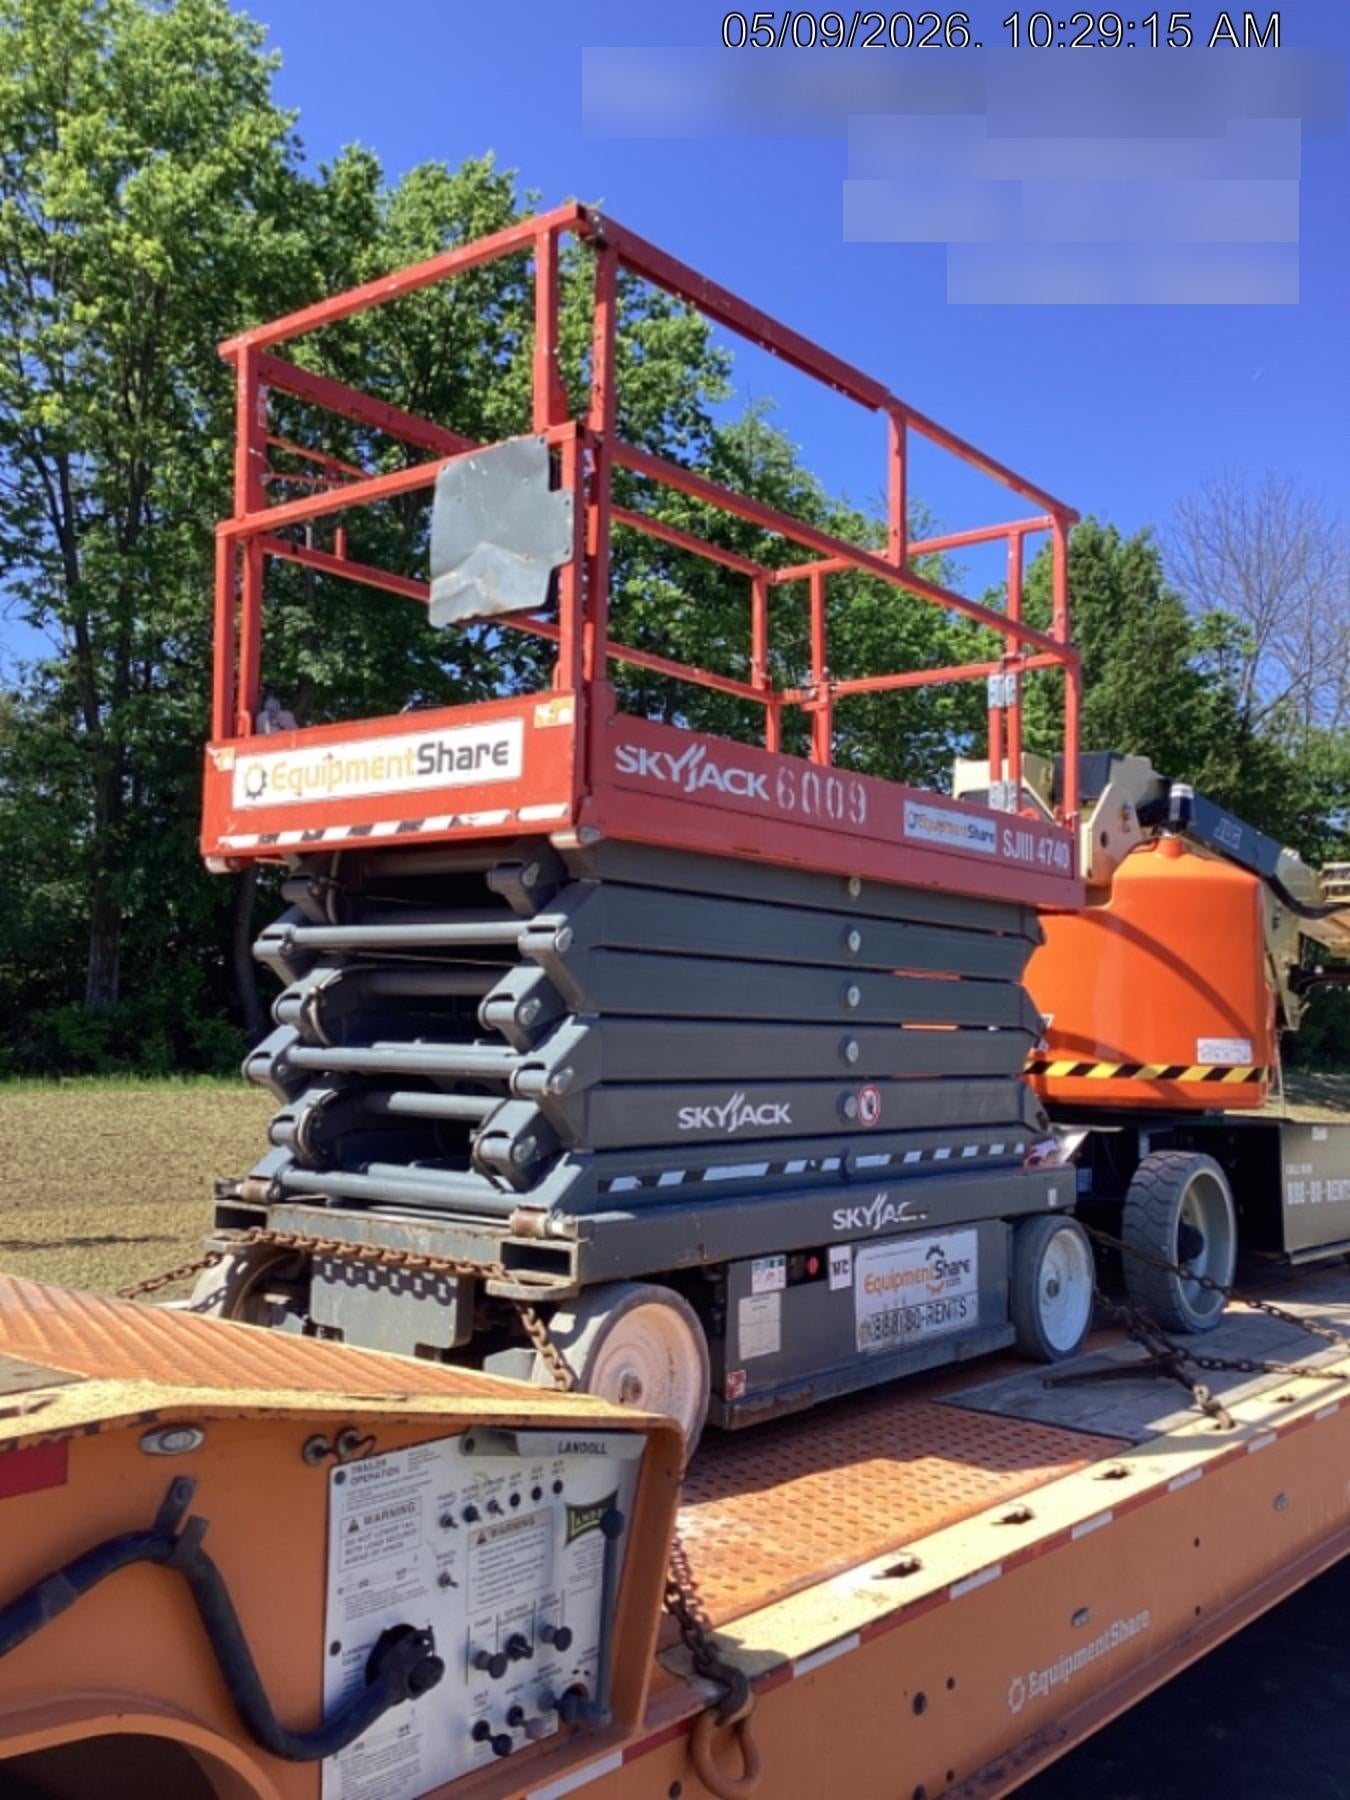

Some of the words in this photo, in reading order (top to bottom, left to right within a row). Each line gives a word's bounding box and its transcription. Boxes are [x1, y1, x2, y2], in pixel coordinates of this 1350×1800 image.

[270, 740, 510, 797] EquipmentShare
[615, 742, 771, 801] SKYJACK
[776, 765, 867, 825] 6009
[677, 1091, 793, 1133] SKYJACK
[832, 1192, 928, 1230] SKYJAC
[863, 1258, 970, 1296] EquipmentShare
[557, 1440, 608, 1456] LANDOLL
[1027, 1608, 1151, 1699] EquipmentShare
